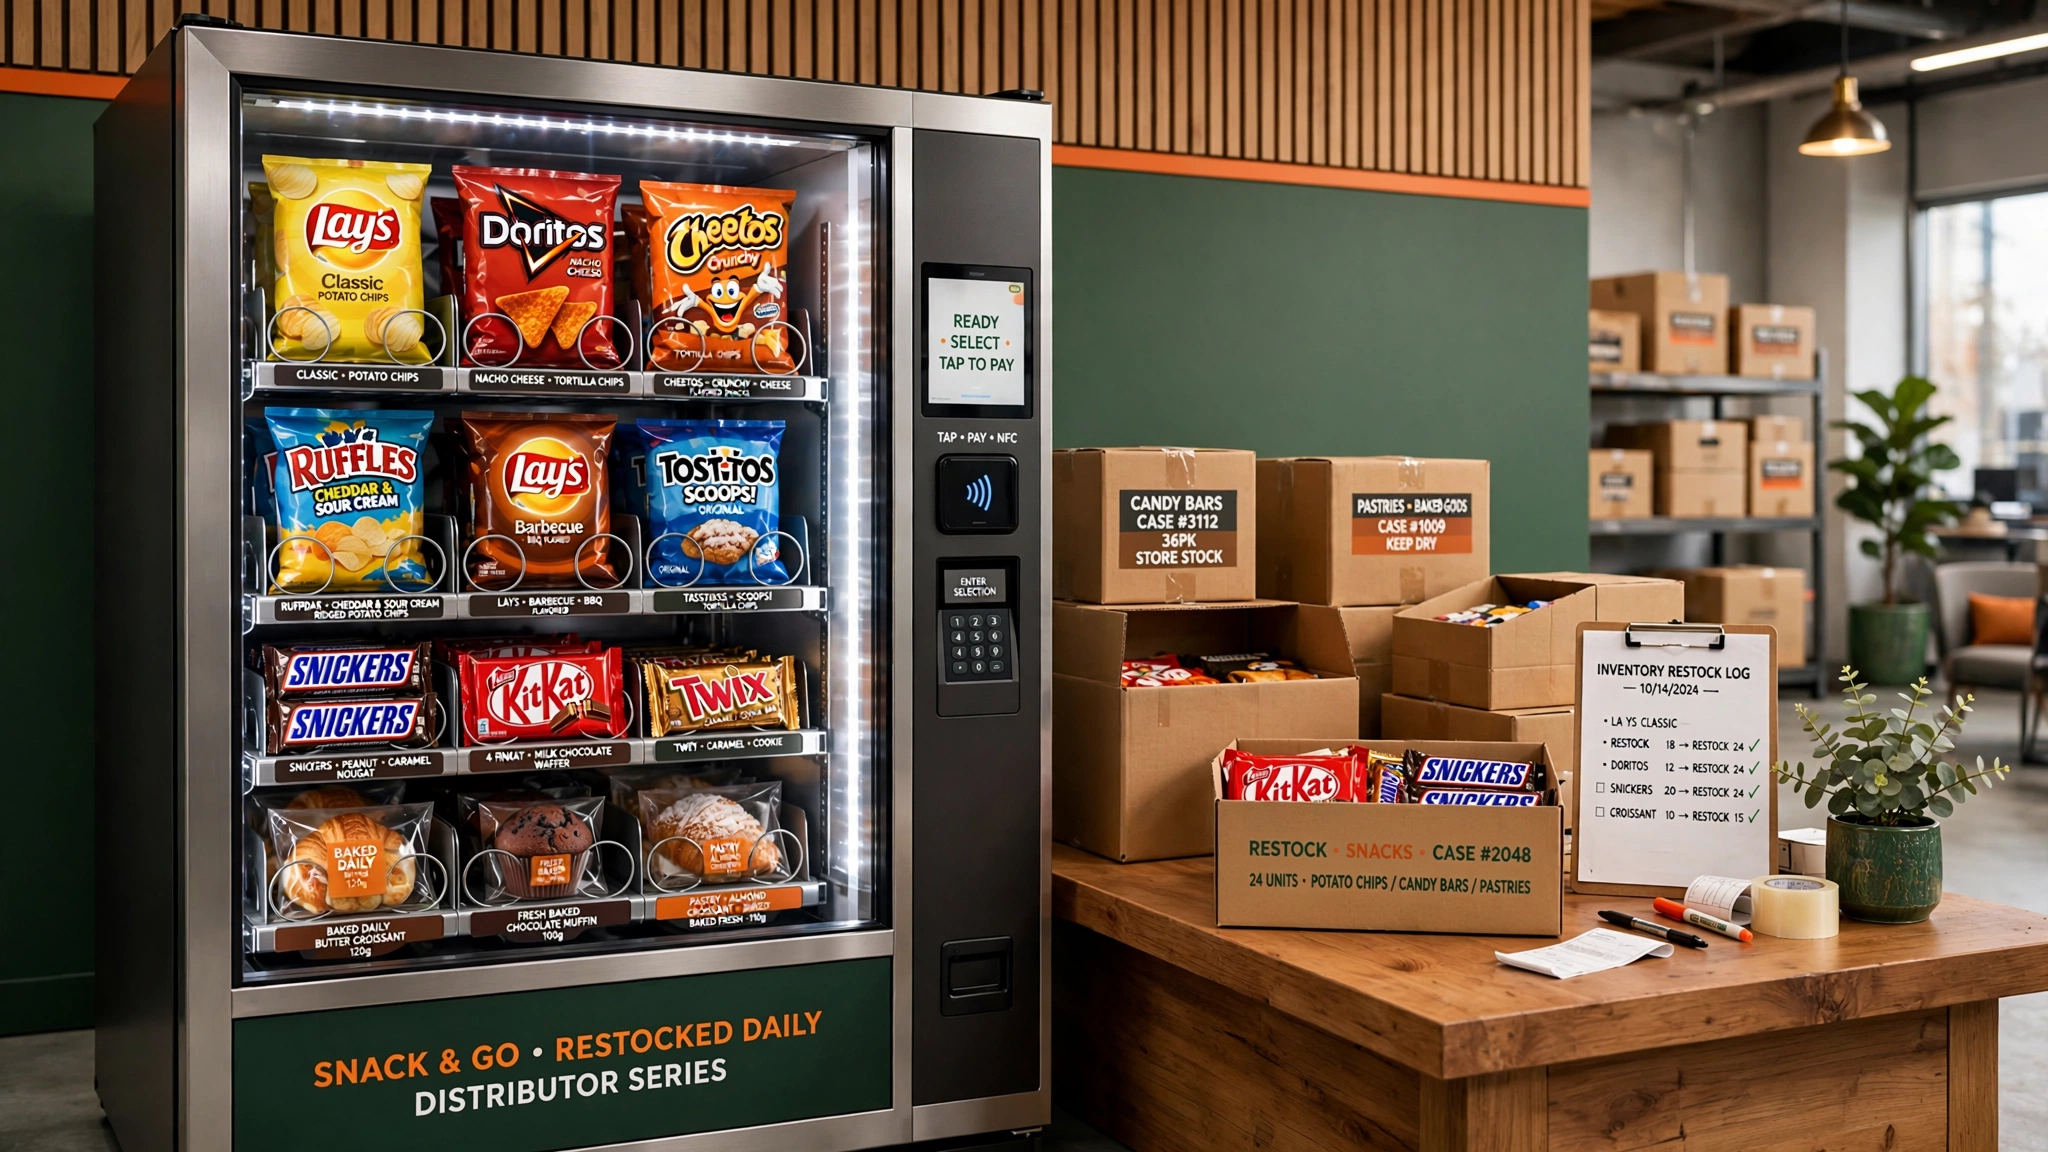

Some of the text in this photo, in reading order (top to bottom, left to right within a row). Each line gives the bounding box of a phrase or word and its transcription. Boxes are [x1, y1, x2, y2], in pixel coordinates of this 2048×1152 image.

[312, 206, 394, 253] Lay's
[483, 215, 605, 248] Doritos
[667, 206, 781, 270] Cheetos
[322, 273, 383, 291] Classic
[318, 290, 389, 303] POTATO CHIPS
[954, 314, 999, 329] READY
[950, 334, 1000, 350] SELECT
[939, 356, 1014, 371] TAP TO PAY
[296, 370, 419, 382] CLASSIC POTATO CHIPS
[475, 374, 624, 386] NACHO CHEESE TORTILLA CHIPS
[664, 378, 703, 387] CHEETOS
[760, 380, 791, 390] CHEESE
[937, 432, 1018, 444] TAP PAY NFC
[287, 442, 416, 490] RUFFLES
[511, 454, 584, 499] Lay's
[315, 481, 392, 502] CHEDDAR &
[684, 486, 757, 504] SCOOPS!
[316, 495, 398, 516] SOUR CREAM
[1130, 496, 1222, 511] CANDY BARS
[1357, 498, 1405, 514] PASTRIES
[515, 520, 584, 534] Barbecue
[1137, 514, 1218, 529] CASE #3112
[1378, 519, 1446, 534] CASE #1009
[1162, 534, 1196, 548] 36PK
[1386, 537, 1437, 550] KEEP DRY
[1136, 550, 1222, 564] STORE STOCK
[960, 577, 986, 586] ENTER
[954, 587, 996, 596] SELECTION
[384, 600, 408, 609] SOUR
[410, 598, 440, 608] CREAM
[529, 597, 574, 606] BARBECUE
[584, 596, 602, 606] BBQ
[314, 609, 408, 620] RIDGED POTATO CHIPS
[955, 616, 997, 626] 1 2 3
[955, 632, 961, 641] 4
[288, 653, 410, 686] SNICKERS
[1597, 663, 1750, 680] INVENTORY RESTOCK LOG
[503, 664, 586, 724] KitKat
[1640, 683, 1698, 696] 10/14/2024
[290, 704, 414, 739] SNICKERS
[1640, 718, 1678, 728] CLASSIC
[707, 737, 782, 750] CARAMEL COOKIE
[1610, 738, 1744, 752] RESTOCK 18 RESTOCK 24
[486, 753, 492, 762] 4
[559, 746, 612, 758] CHOCOLATE
[342, 758, 378, 769] PEANUT
[388, 756, 431, 766] CARAMEL
[1611, 760, 1744, 774] DORITOS 12 RESTOCK 24
[337, 768, 375, 780] NOUGAT
[1421, 758, 1526, 786] SNICKERS
[1256, 766, 1332, 802] KitKat
[1610, 783, 1744, 798] SNICKERS 20 RESTOCK 24
[1610, 808, 1744, 822] CROISSANT 10 RESTOCK 15
[334, 844, 377, 858] BAKED
[1249, 840, 1532, 862] RESTOCK SNACKS CASE #2048
[338, 856, 376, 871] DAILY
[1249, 873, 1531, 894] 24 UNITS POTATO CHIPS CANDY BARS PASTRIES
[518, 907, 580, 921] FRESH BAKED
[327, 922, 390, 936] BAKED DAILY
[506, 916, 598, 932] CHOCOLATE MUFFIN
[315, 932, 406, 948] BUTTER CROISSANT
[542, 930, 564, 942] 100g
[350, 947, 372, 957] 120g
[313, 1010, 824, 1088] SNACK & GO RESTOCKED DAILY
[414, 1058, 728, 1116] DISTRIBUTOR SERIES
